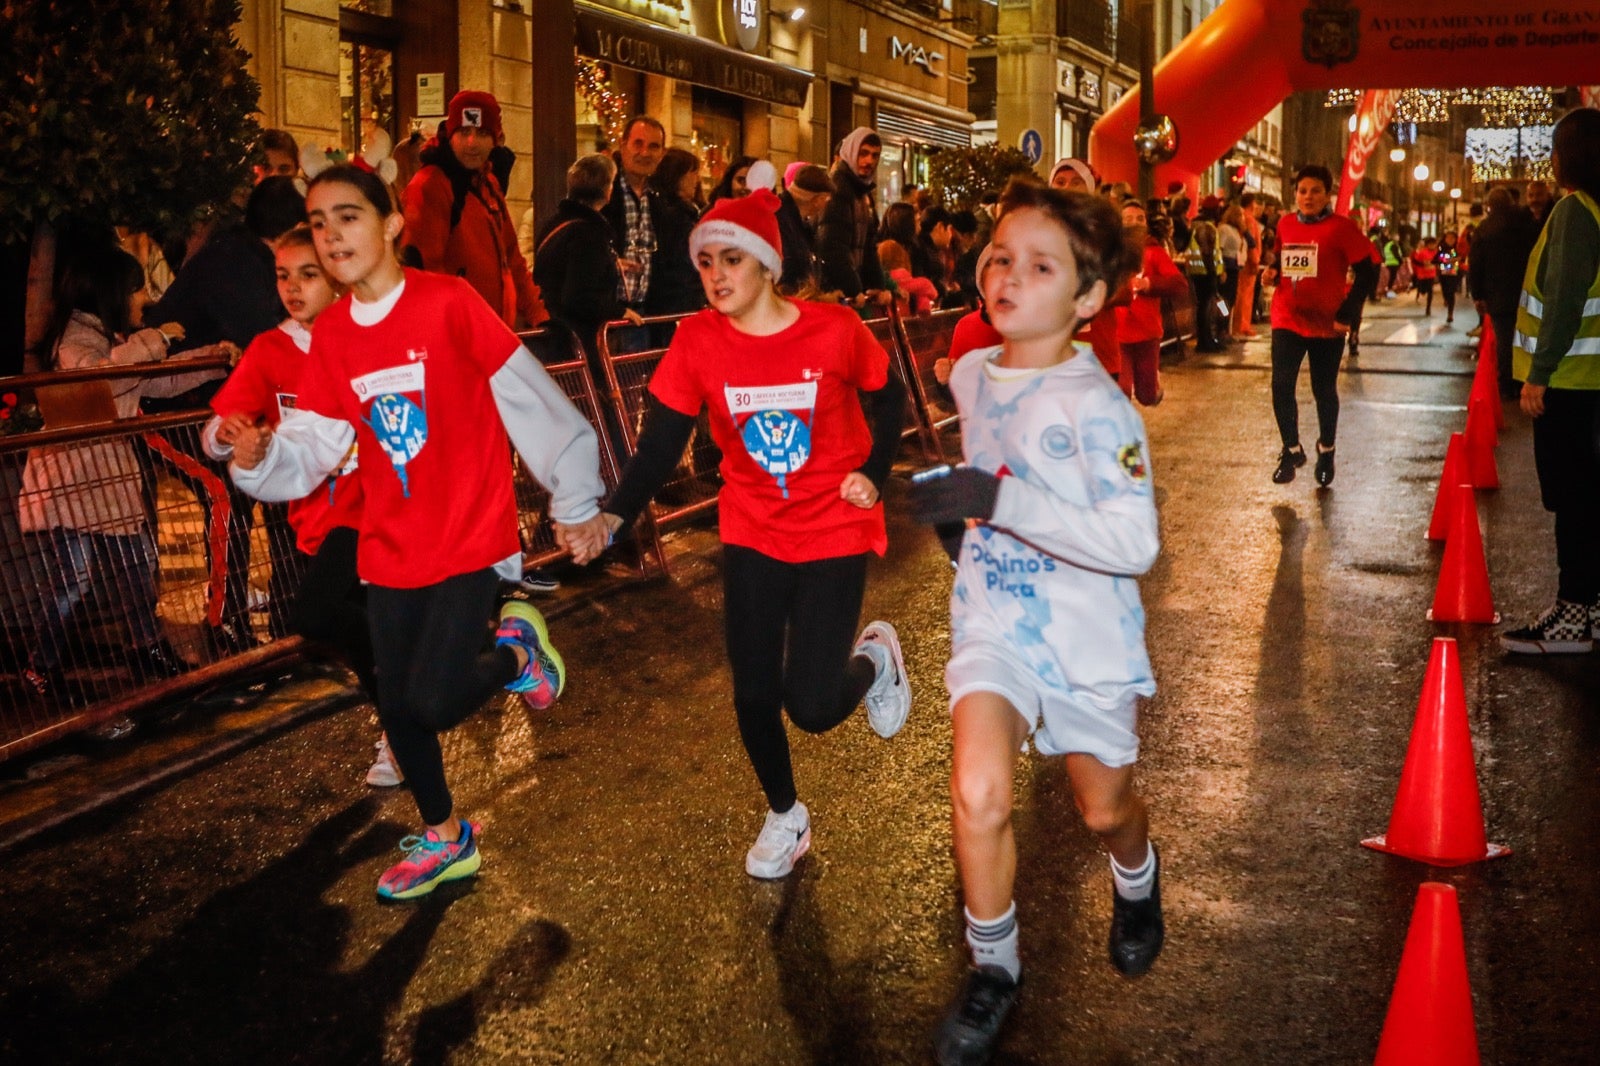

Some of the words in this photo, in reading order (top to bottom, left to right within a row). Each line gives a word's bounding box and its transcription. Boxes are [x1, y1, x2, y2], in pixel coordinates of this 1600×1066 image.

[1370, 13, 1510, 32] AYUNTAMIENTO
[1514, 12, 1536, 26] DE
[1542, 9, 1600, 26] GRAN
[1494, 32, 1519, 48] de
[1526, 29, 1600, 48] Deporte
[616, 35, 664, 72] CUEVA
[891, 35, 945, 78] MAC
[1285, 255, 1309, 267] 128
[735, 393, 751, 407] 30
